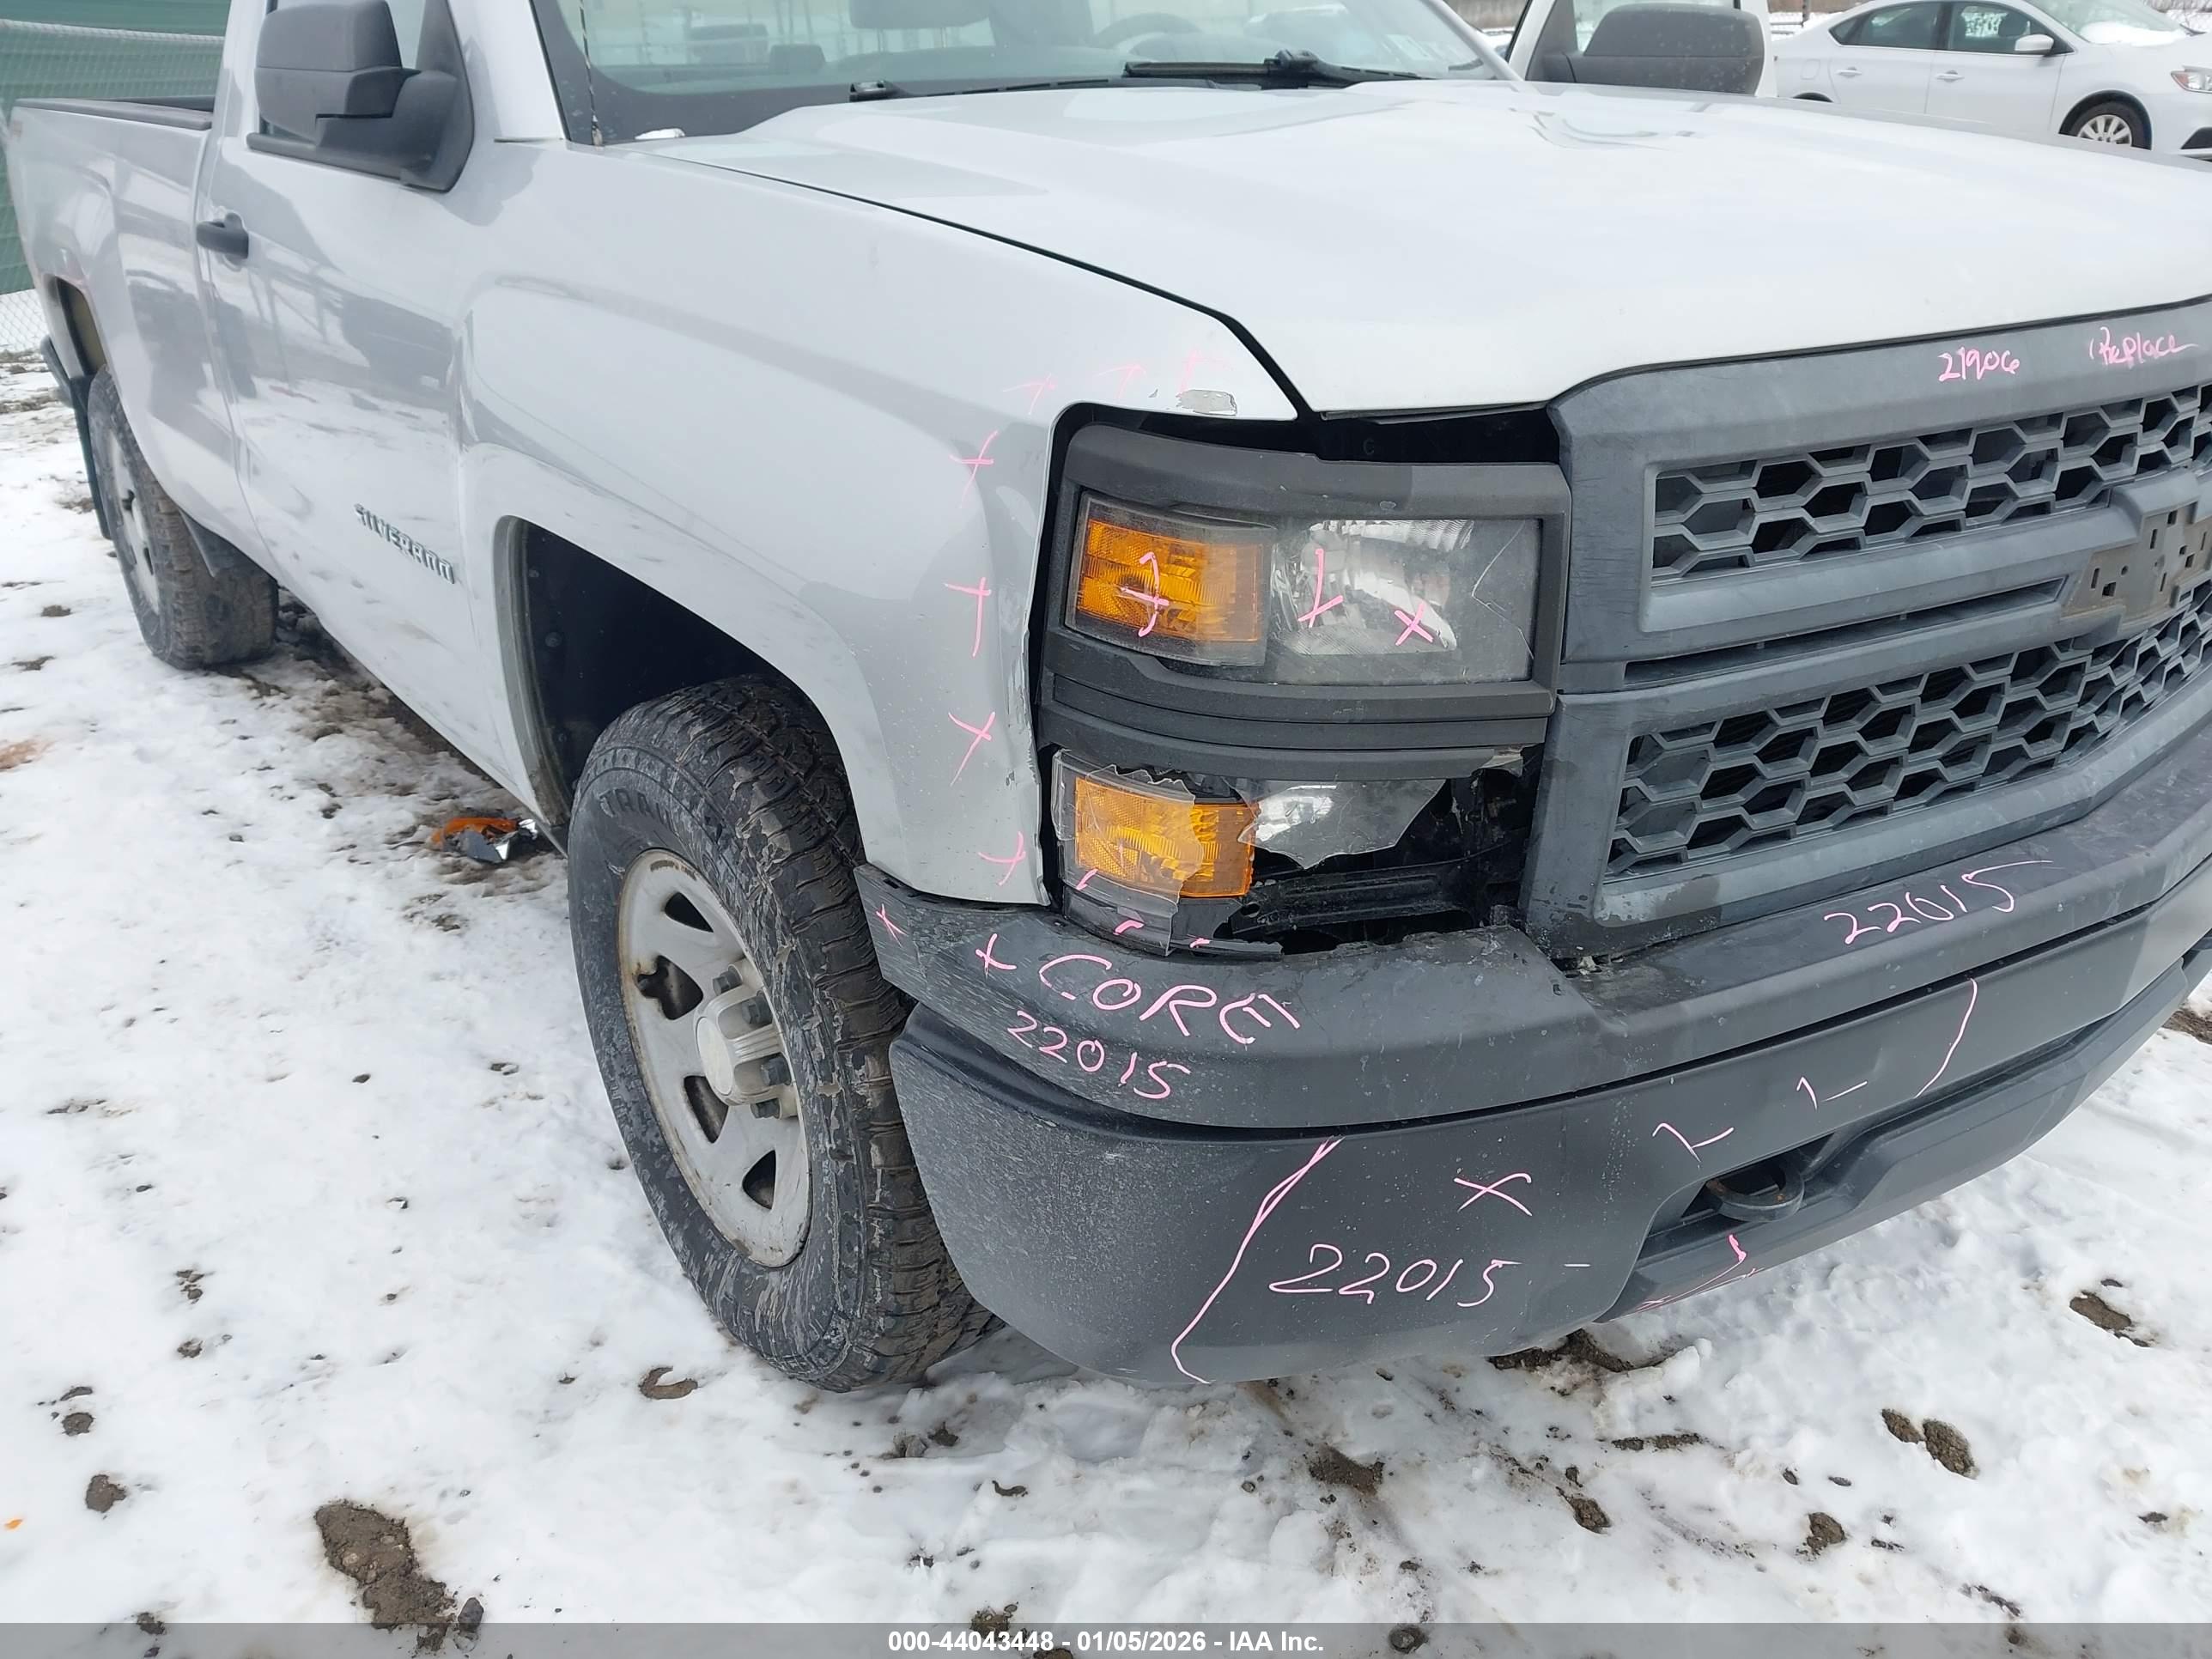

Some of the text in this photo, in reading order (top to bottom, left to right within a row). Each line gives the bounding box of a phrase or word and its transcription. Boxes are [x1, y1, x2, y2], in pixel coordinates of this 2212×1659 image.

[1938, 346, 2021, 382] 21906
[353, 503, 455, 585] SILVERADO
[1823, 860, 2053, 945] 22015
[1039, 954, 1301, 1045] CORE
[1007, 1010, 1191, 1099] 22015
[1268, 1243, 1522, 1307] 22015
